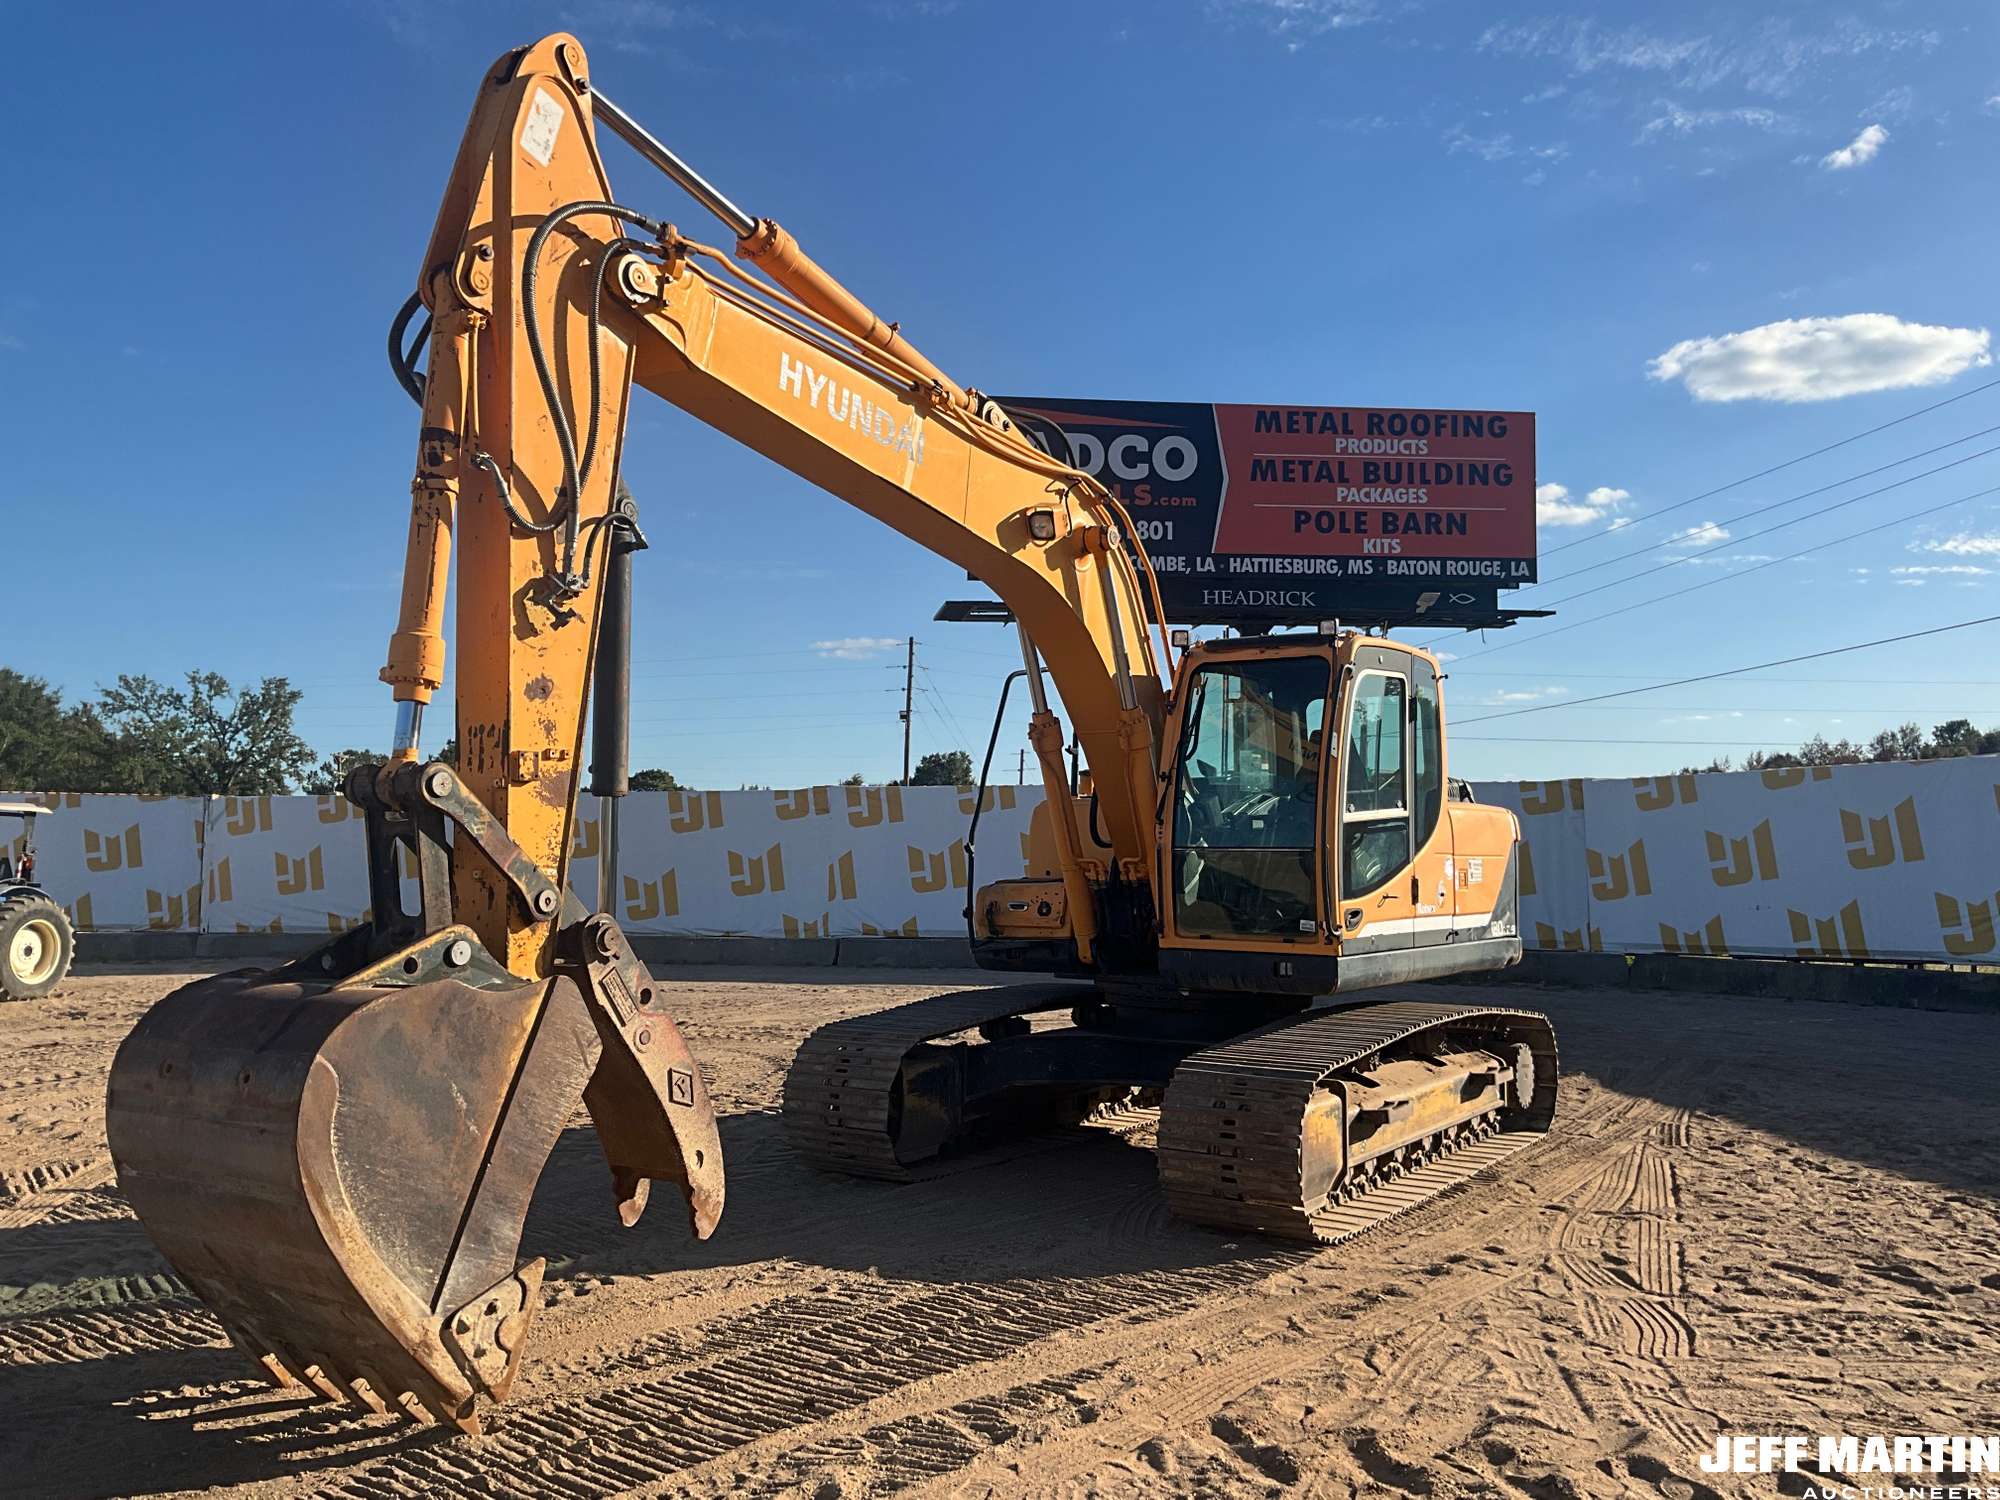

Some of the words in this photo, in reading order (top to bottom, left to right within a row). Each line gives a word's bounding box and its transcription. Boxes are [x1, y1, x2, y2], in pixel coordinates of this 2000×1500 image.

[778, 351, 925, 464] HYUNDAI
[1254, 409, 1354, 435] METAL
[1367, 412, 1508, 438] ROOFING
[1335, 438, 1429, 455] PRODUCTS
[1250, 459, 1350, 483] METAL
[1363, 461, 1514, 487] BUILDING
[1336, 487, 1428, 505] PACKAGES
[1294, 510, 1368, 535] POLE
[1382, 512, 1468, 536] BARN
[1363, 538, 1402, 554] KITS
[1196, 557, 1216, 572] LA
[1229, 557, 1343, 577] HATTIESBURG,
[1347, 559, 1374, 575] MS
[1387, 560, 1441, 576] BATON
[1446, 560, 1506, 579] ROUGE,
[1510, 561, 1530, 577] LA
[1202, 590, 1317, 607] HEADRICK
